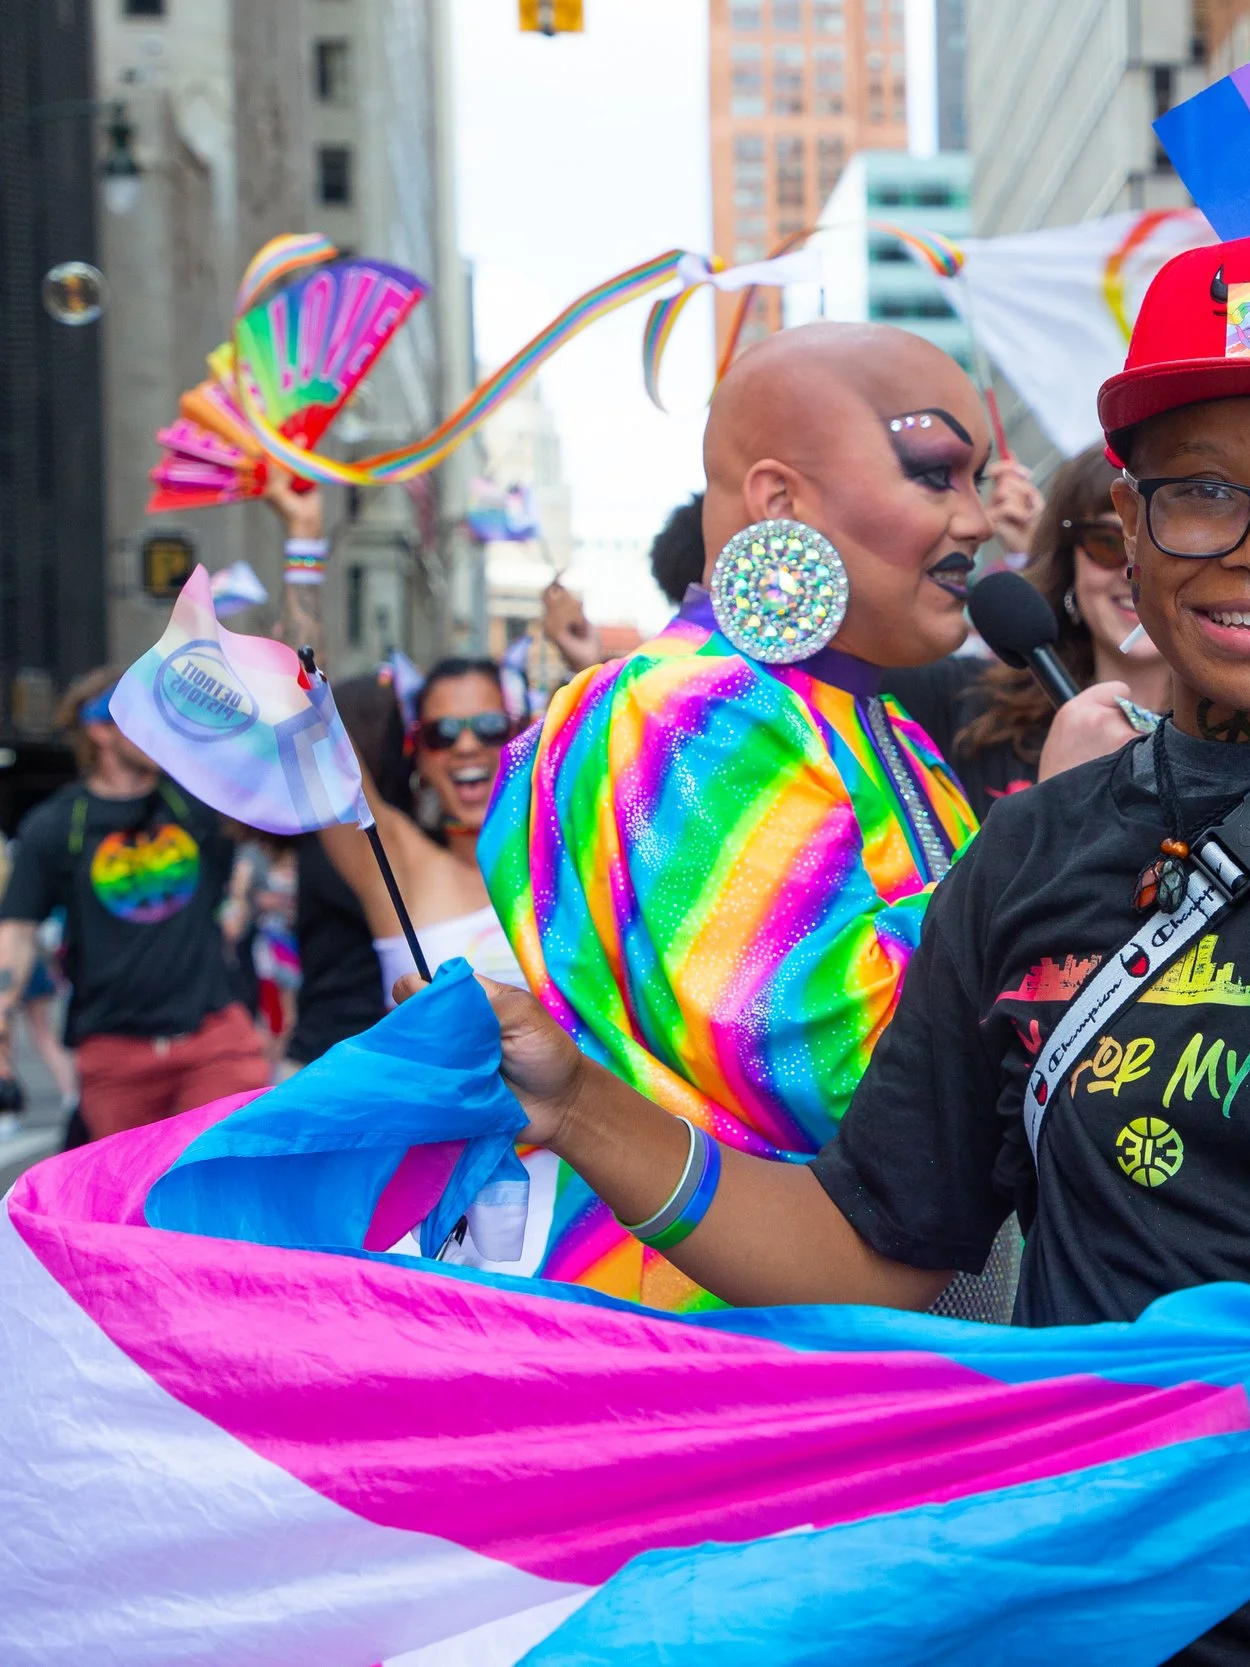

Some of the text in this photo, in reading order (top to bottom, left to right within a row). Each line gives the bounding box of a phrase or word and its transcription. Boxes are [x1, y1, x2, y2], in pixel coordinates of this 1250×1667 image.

[1151, 885, 1216, 947] Champ
[1048, 978, 1123, 1073] Champion
[1116, 1126, 1184, 1177] 313
